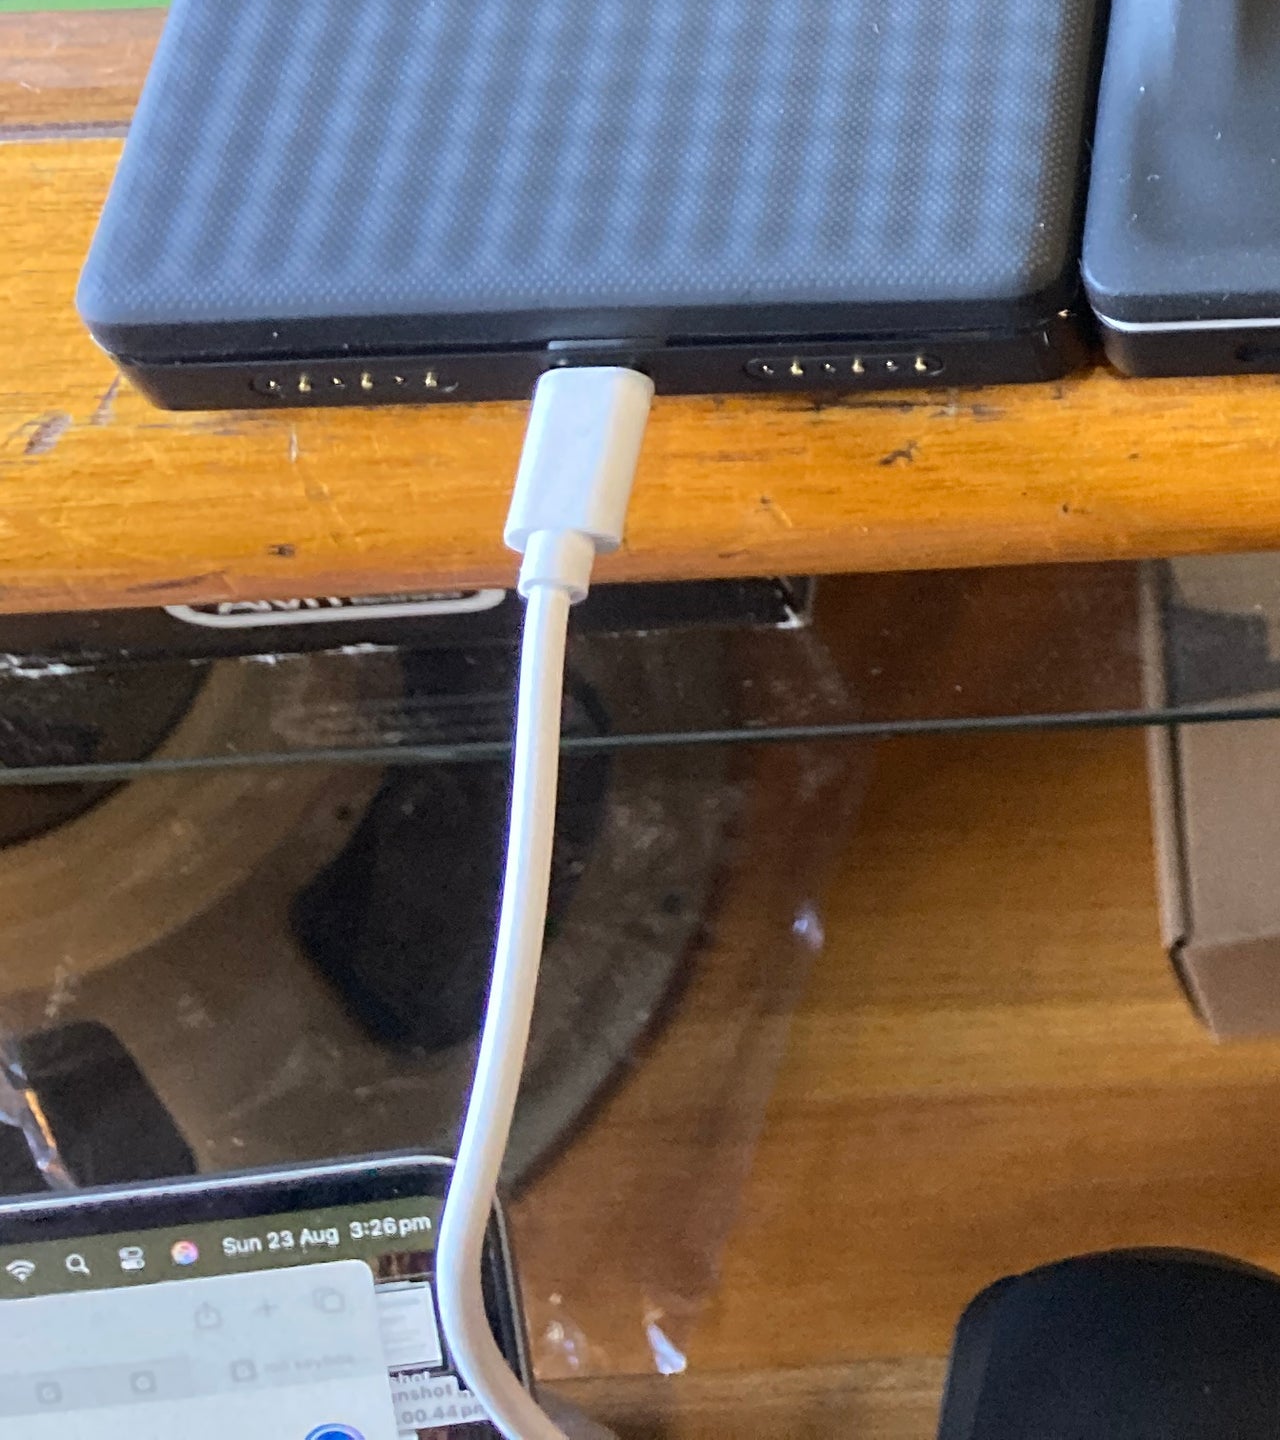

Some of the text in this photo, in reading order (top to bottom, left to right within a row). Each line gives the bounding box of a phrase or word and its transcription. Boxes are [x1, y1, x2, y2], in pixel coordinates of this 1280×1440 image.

[222, 1236, 263, 1255] Sun
[266, 1230, 295, 1250] 23
[299, 1227, 340, 1247] Aug
